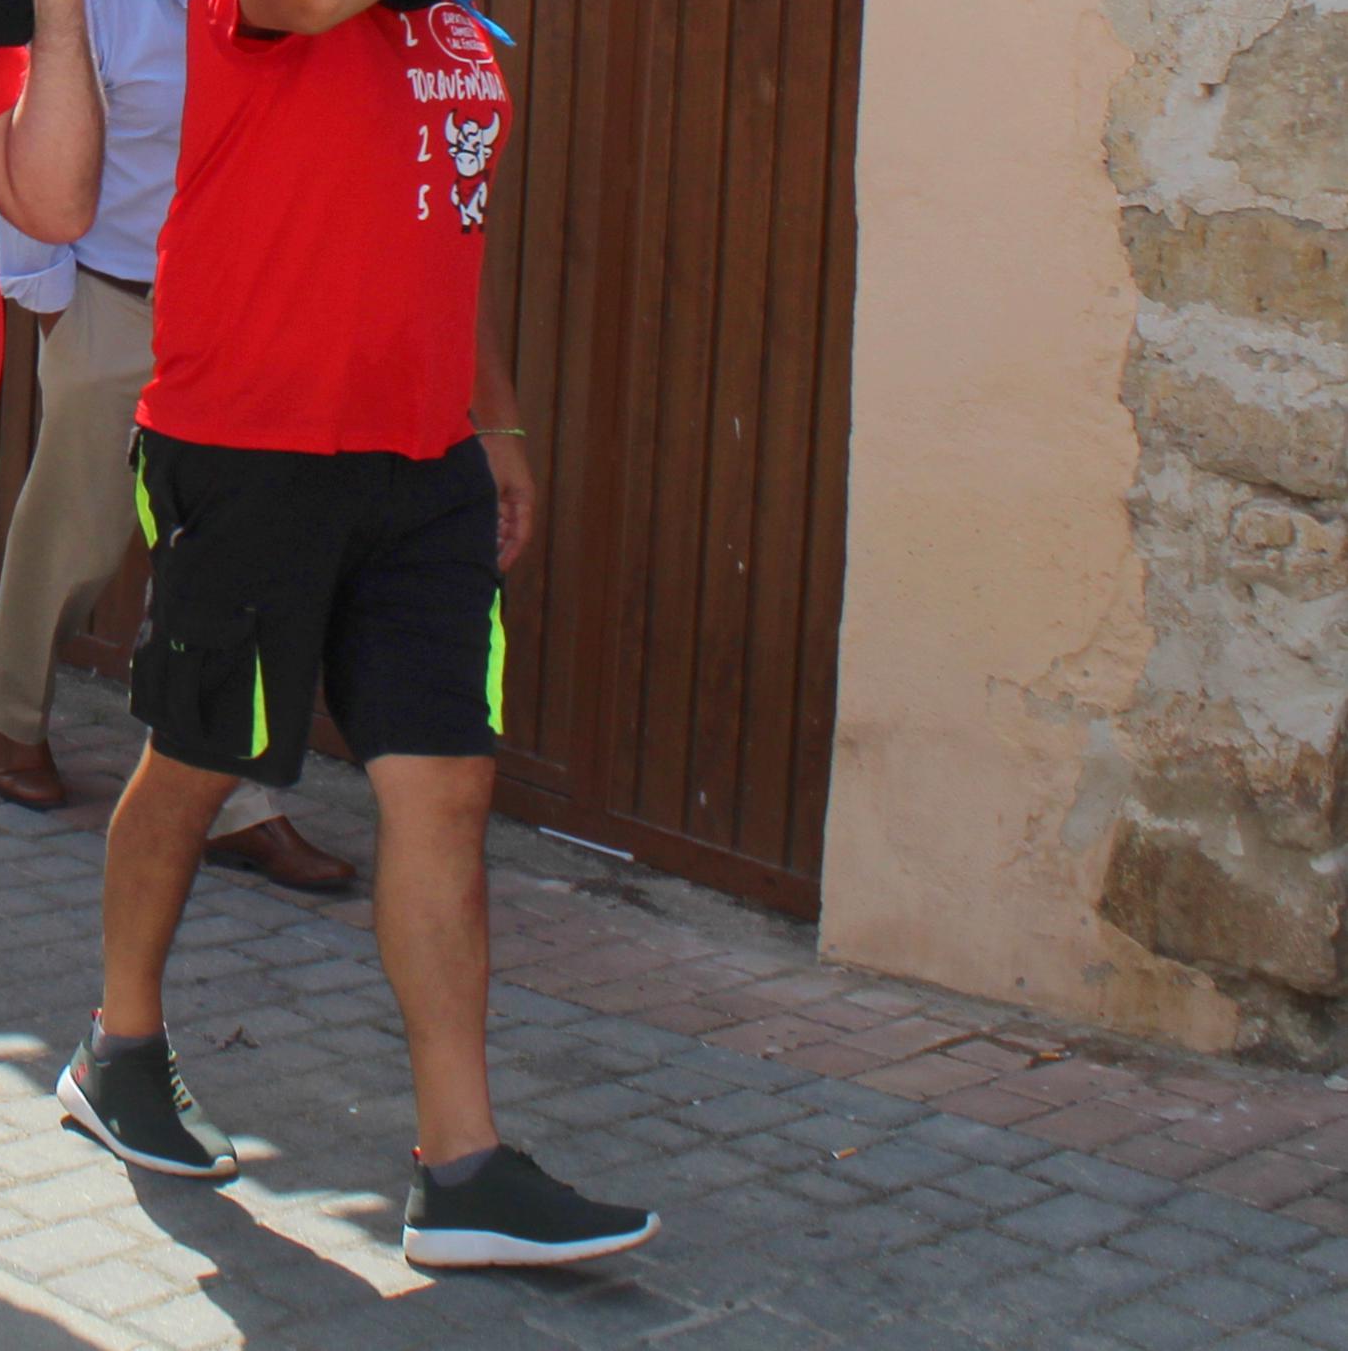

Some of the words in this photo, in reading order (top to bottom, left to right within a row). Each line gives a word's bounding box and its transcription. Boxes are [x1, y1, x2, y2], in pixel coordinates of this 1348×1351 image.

[399, 12, 419, 47] 2
[407, 67, 506, 103] TORQUEMADA
[417, 125, 431, 162] 2
[417, 183, 430, 221] 5
